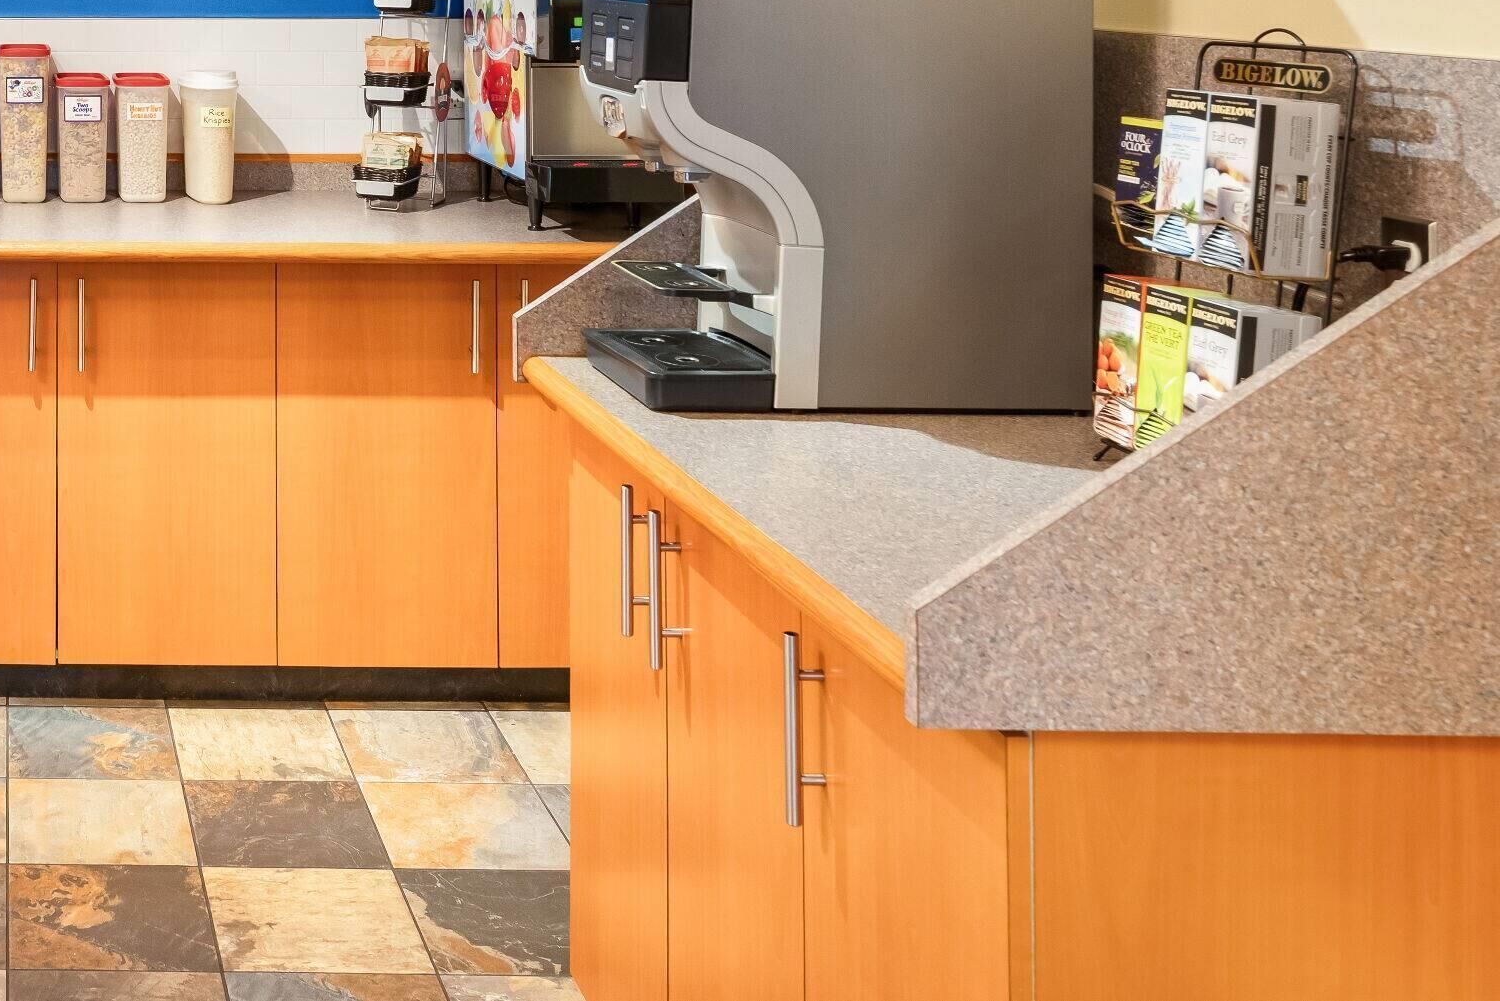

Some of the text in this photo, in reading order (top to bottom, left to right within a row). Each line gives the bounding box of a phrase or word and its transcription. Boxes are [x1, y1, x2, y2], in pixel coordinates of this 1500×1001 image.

[208, 108, 225, 117] Rice
[203, 116, 231, 126] Krispies
[1124, 131, 1146, 142] FOUR
[1228, 132, 1249, 148] Grey
